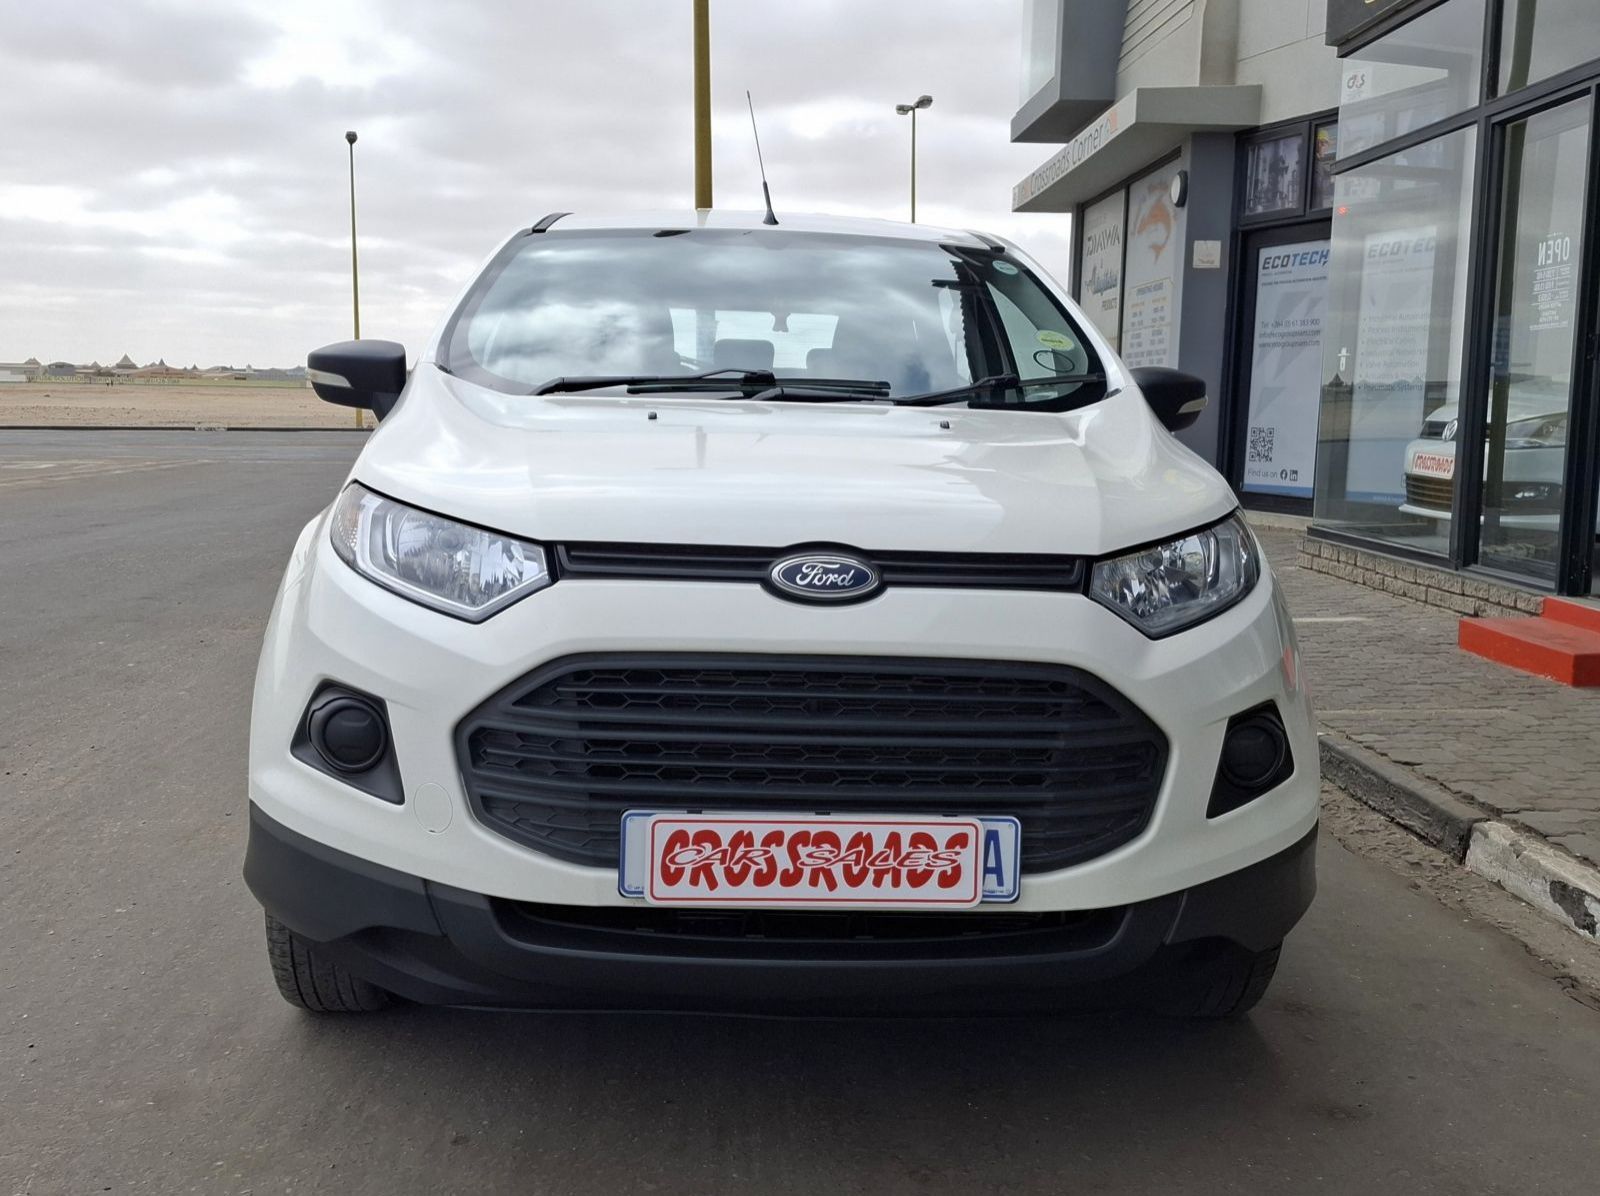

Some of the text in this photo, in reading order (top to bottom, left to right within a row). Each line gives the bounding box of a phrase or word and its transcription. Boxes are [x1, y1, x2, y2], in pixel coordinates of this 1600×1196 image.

[1030, 124, 1104, 196] Crossroads Corner
[1086, 223, 1120, 257] DAIWA
[1262, 249, 1330, 270] ECOTECH
[1310, 318, 1321, 326] 900
[1364, 383, 1423, 393] Pneumatic Systems
[1247, 468, 1261, 477] Find
[796, 563, 855, 586] Ford
[660, 829, 970, 892] CROSSROADS
[666, 843, 962, 870] CAR SALES
